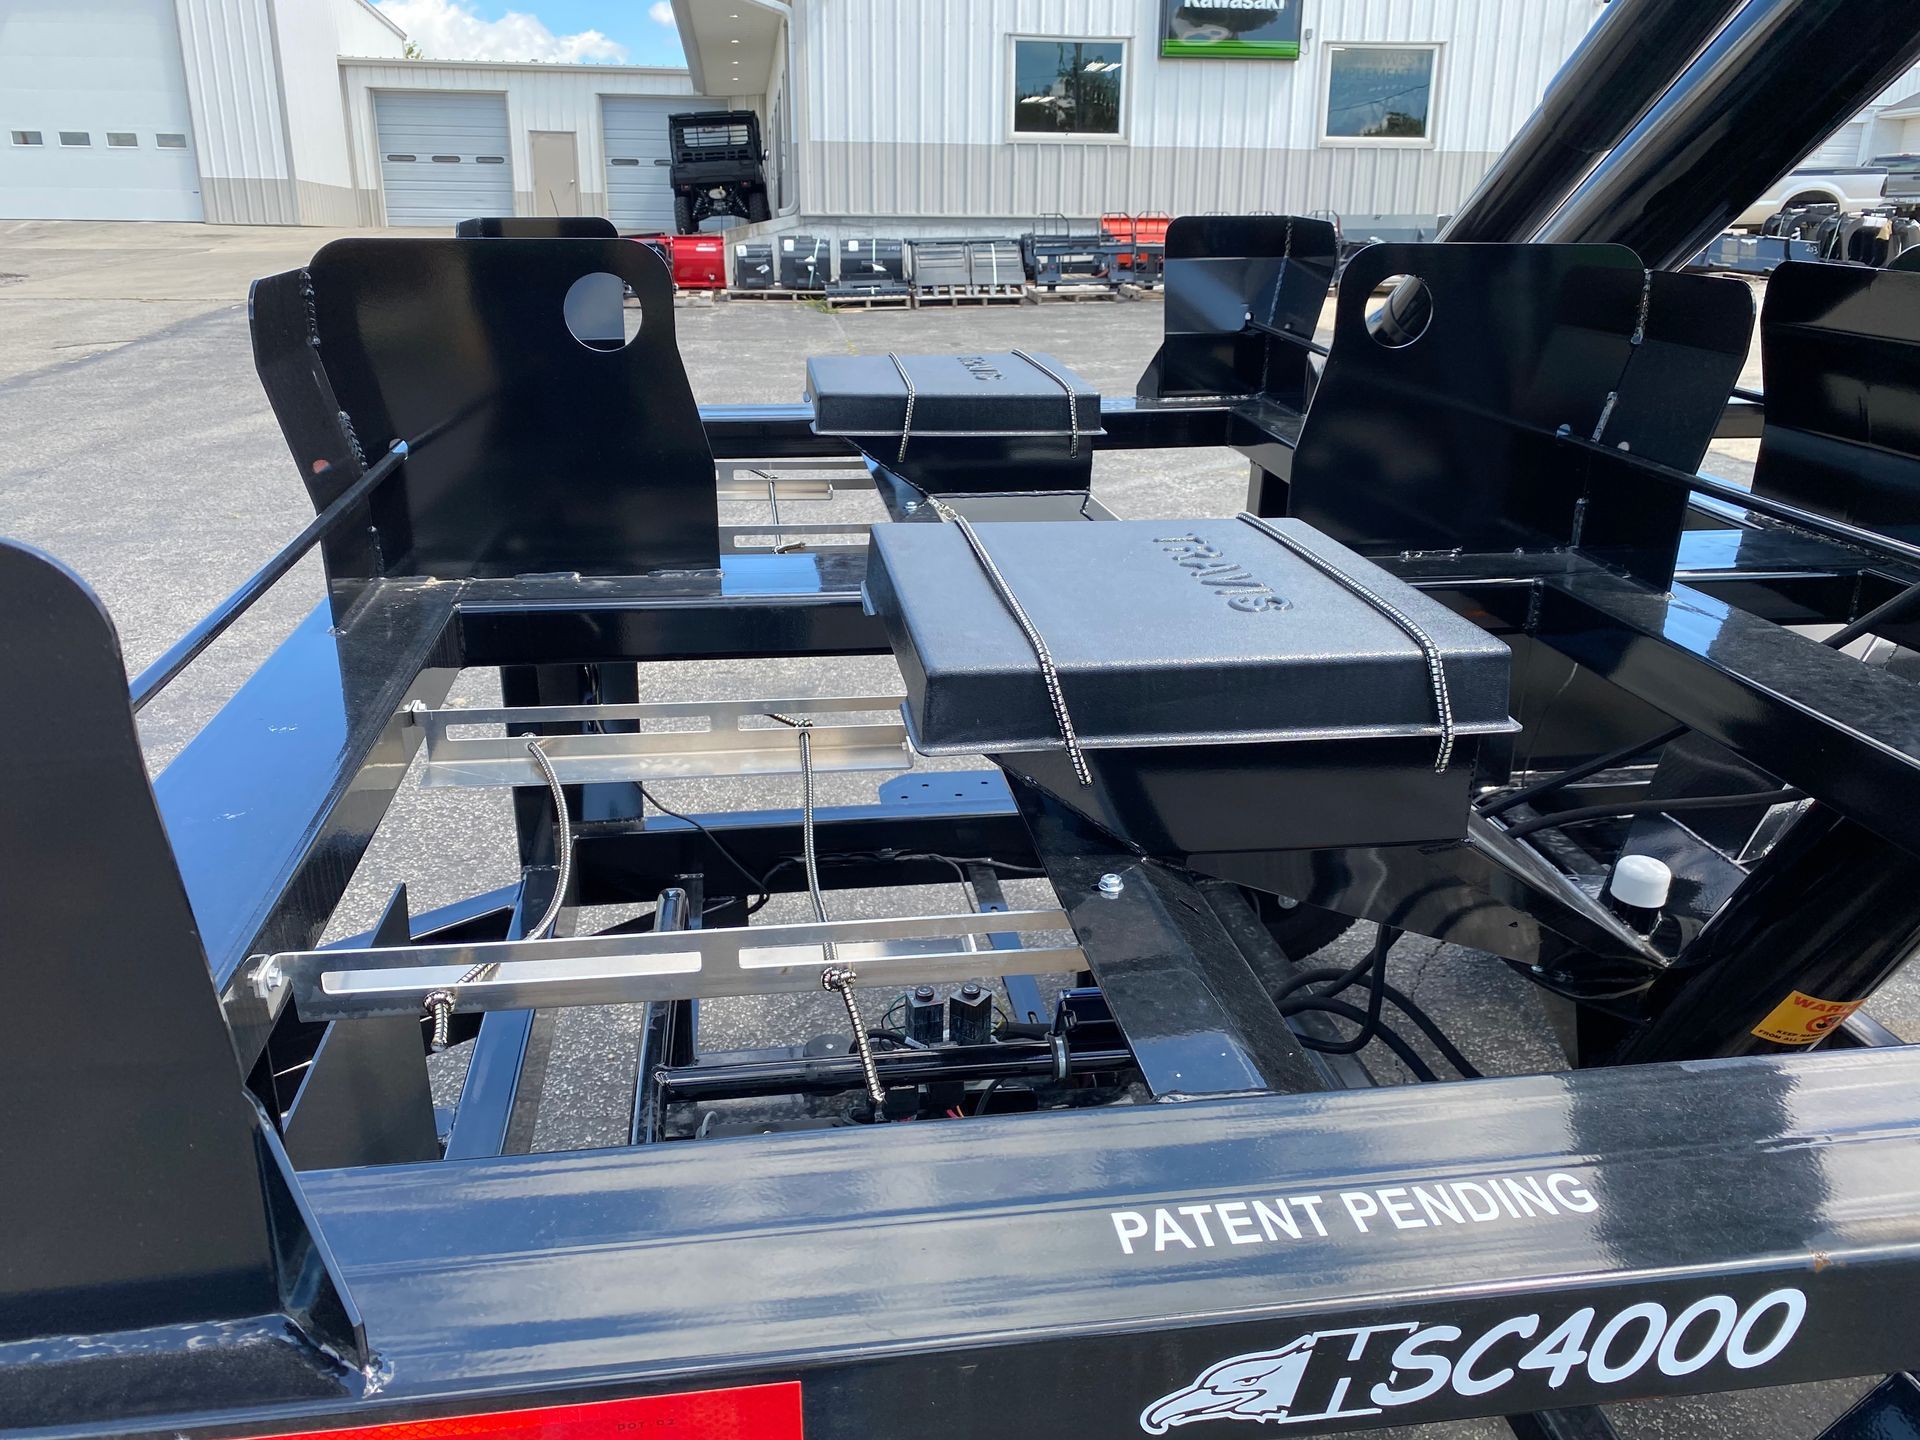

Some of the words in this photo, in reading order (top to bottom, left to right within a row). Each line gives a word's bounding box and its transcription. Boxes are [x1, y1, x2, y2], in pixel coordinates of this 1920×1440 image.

[1183, 0, 1286, 10] Kawasaki
[1152, 532, 1294, 613] TRAVIS
[1111, 1195, 1328, 1255] PATENT
[1342, 1172, 1599, 1233] PENDING
